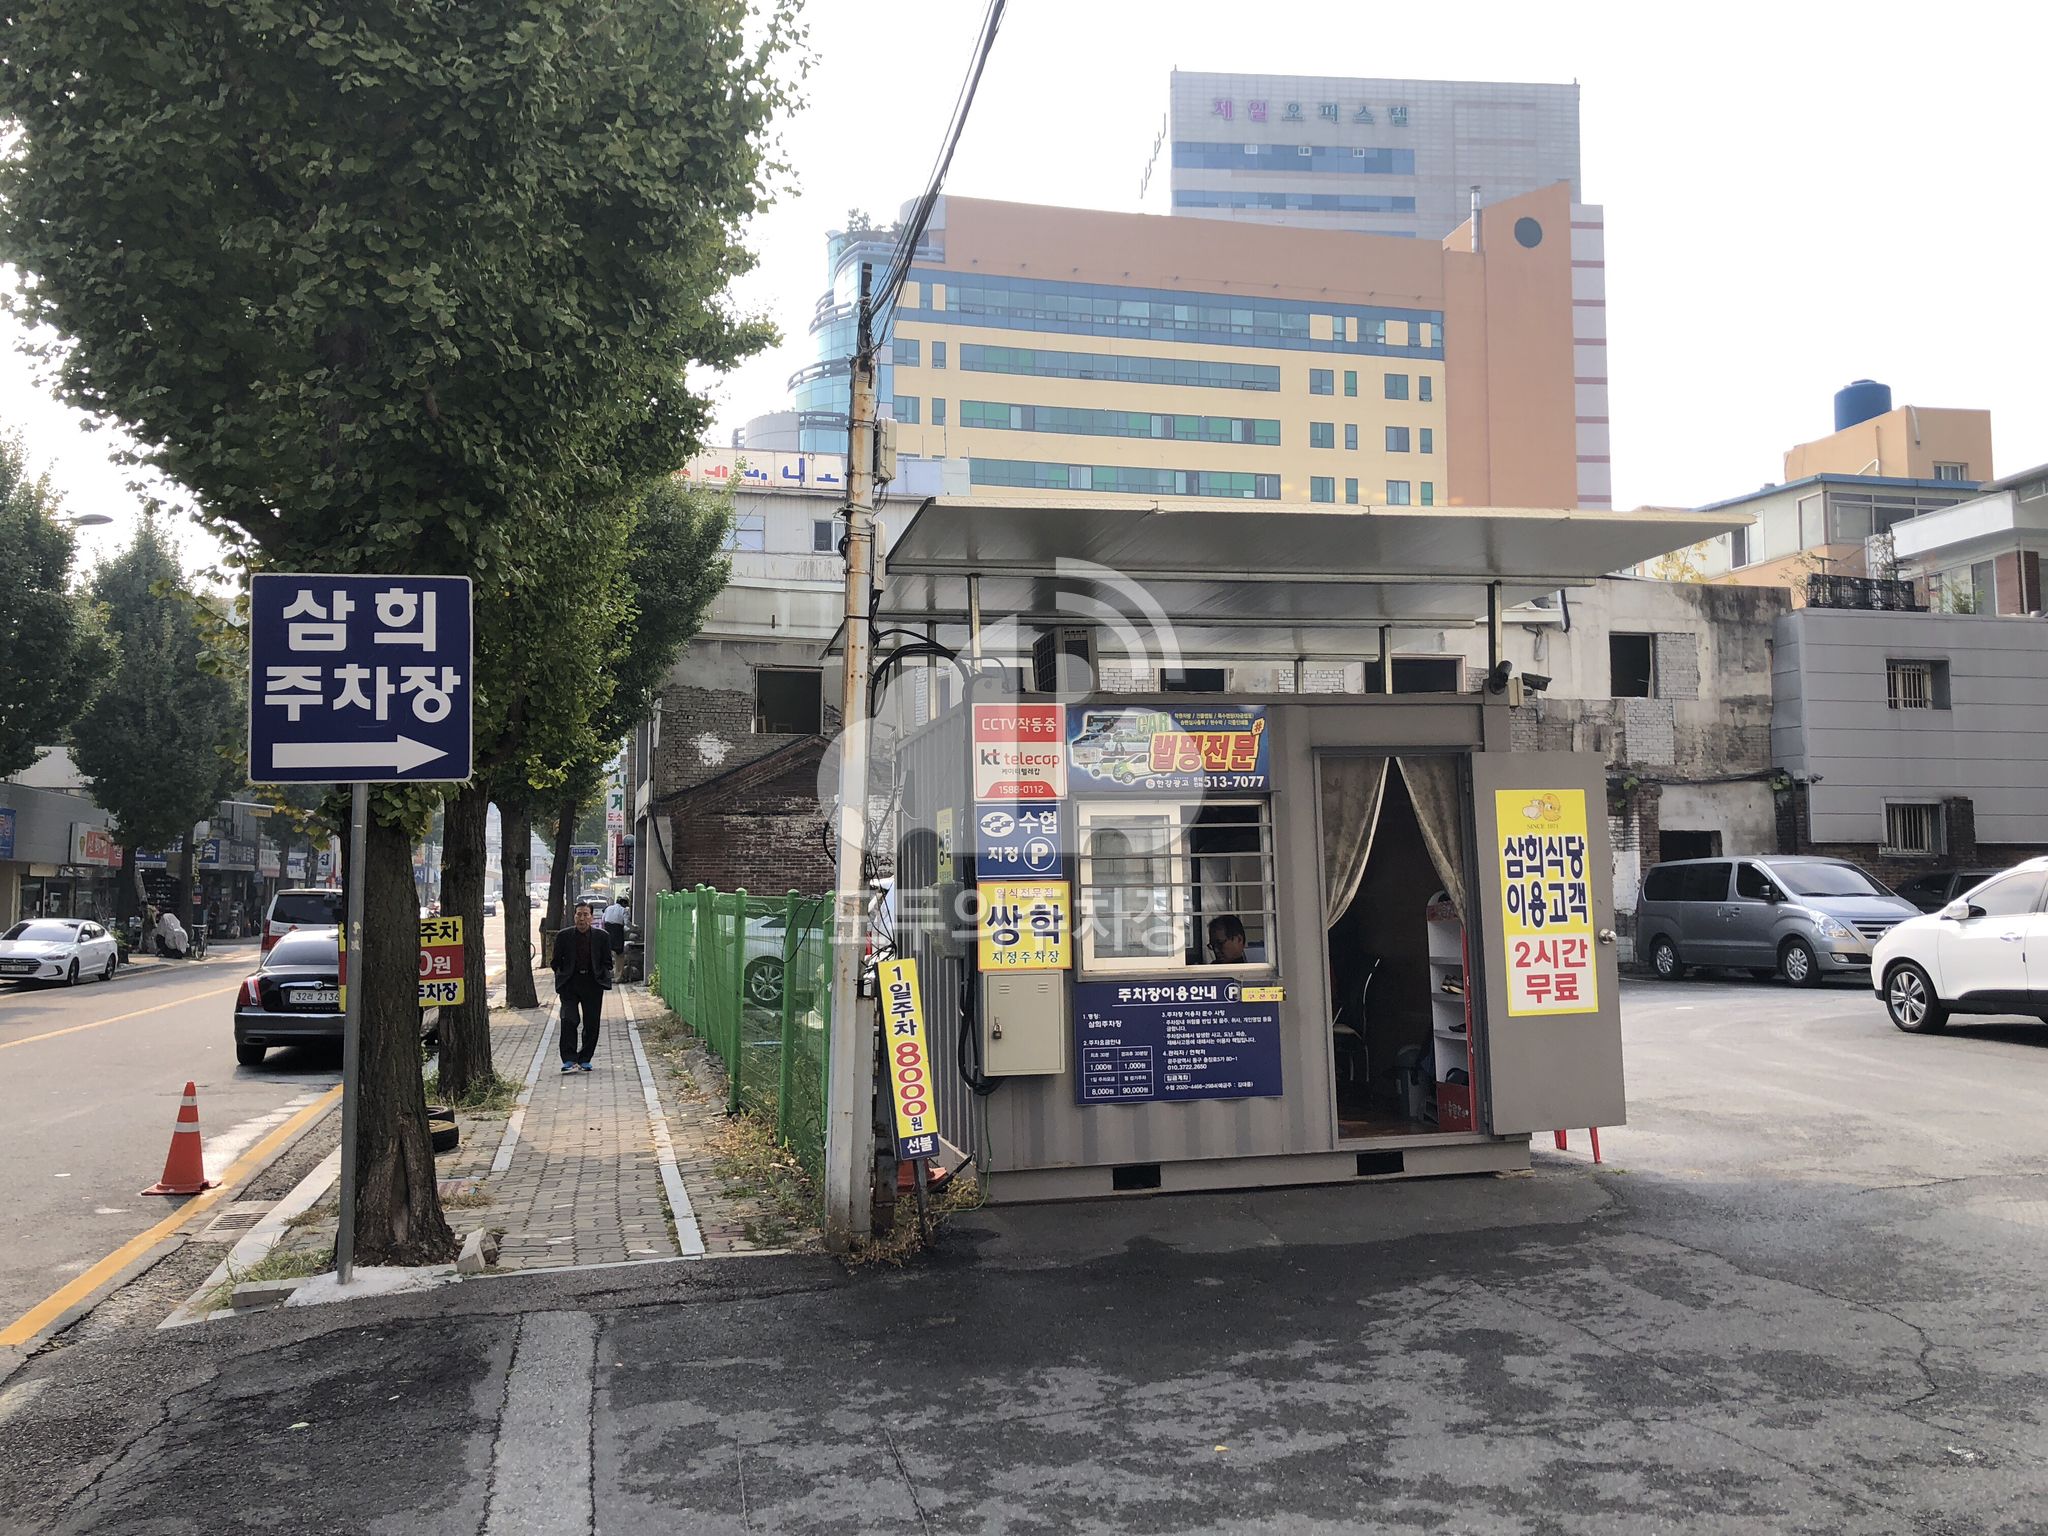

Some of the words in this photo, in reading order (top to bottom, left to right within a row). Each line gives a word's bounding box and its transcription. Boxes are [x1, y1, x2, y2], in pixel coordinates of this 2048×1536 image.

[283, 588, 436, 652] 삼희
[265, 664, 461, 723] 주차장
[982, 717, 1056, 733] CCTV작동중
[981, 749, 1000, 765] kt
[1004, 752, 1060, 768] telecop
[1152, 734, 1258, 771] 랩핑전문
[999, 785, 1044, 793] 1588-0112
[1156, 779, 1190, 789] 한강광고
[1203, 776, 1264, 788] 513-7077
[1019, 811, 1057, 834] 수협
[988, 846, 1019, 863] 지정
[1504, 834, 1585, 880] 삼희식당
[996, 887, 1054, 898] 일식전문점
[1507, 881, 1588, 928] 이용고객
[986, 904, 1063, 945] 쌍학
[992, 950, 1060, 964] 지정주차장
[1514, 939, 1588, 969] 2시간
[1118, 985, 1217, 1002] 주차장이용안내
[1526, 972, 1580, 1004] 무료
[889, 966, 917, 1036] 1일주차
[1088, 1020, 1122, 1029] 삼희주차장
[896, 1042, 928, 1132] 8000원
[907, 1136, 933, 1154] 선불
